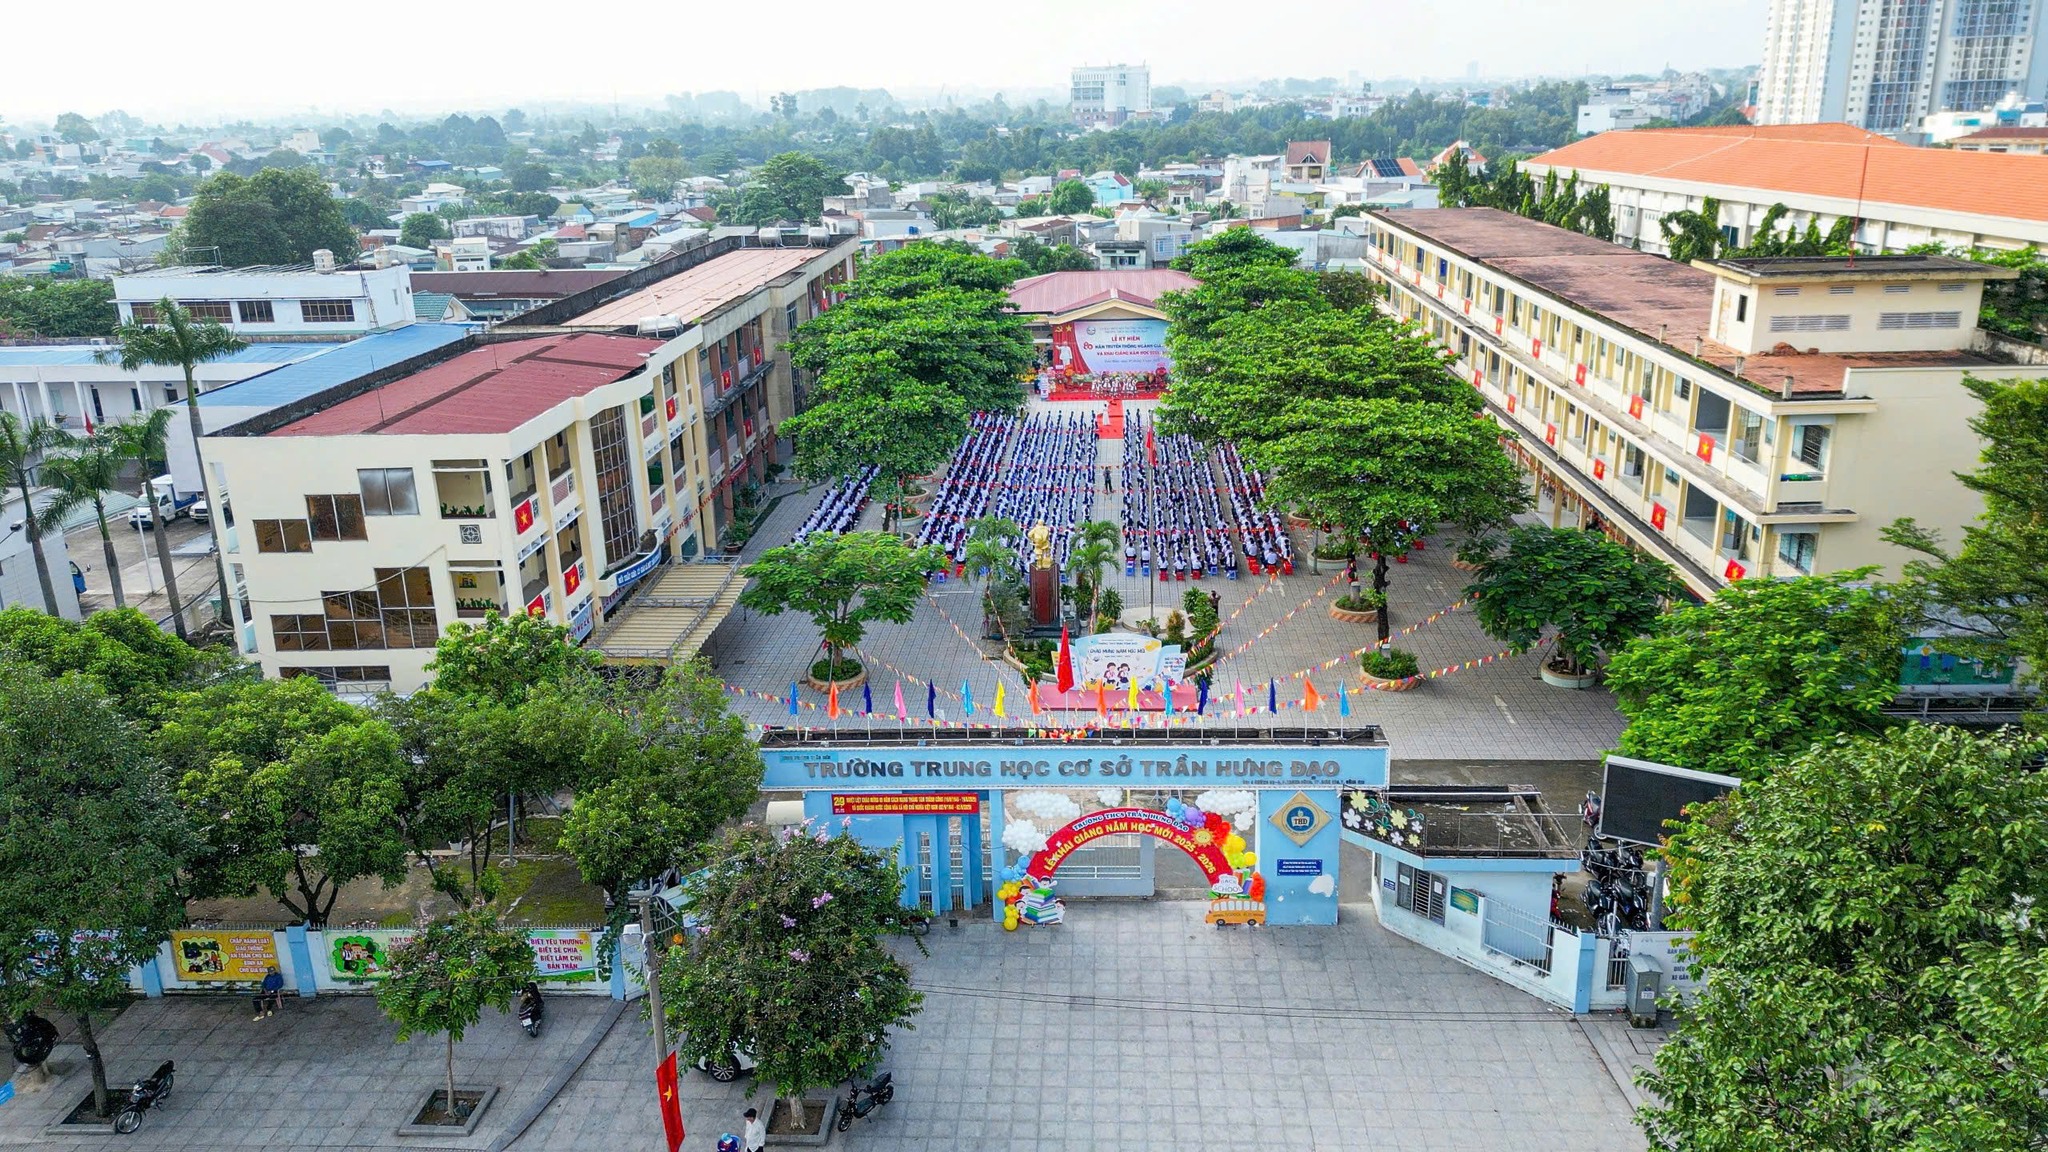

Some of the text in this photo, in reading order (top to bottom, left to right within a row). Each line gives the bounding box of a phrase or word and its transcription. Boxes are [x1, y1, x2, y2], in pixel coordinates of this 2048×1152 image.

[804, 753, 1340, 781] TRƯỜNG TRUNG HỌC CƠ SỞ TRẦN HƯNG ĐẠO
[1074, 826, 1104, 844] GIẢNG
[1106, 821, 1128, 832] NĂM
[1131, 822, 1152, 833] HỌC
[1154, 826, 1174, 839] MỚI
[1174, 834, 1196, 853] 2025
[1197, 853, 1216, 874] 2026
